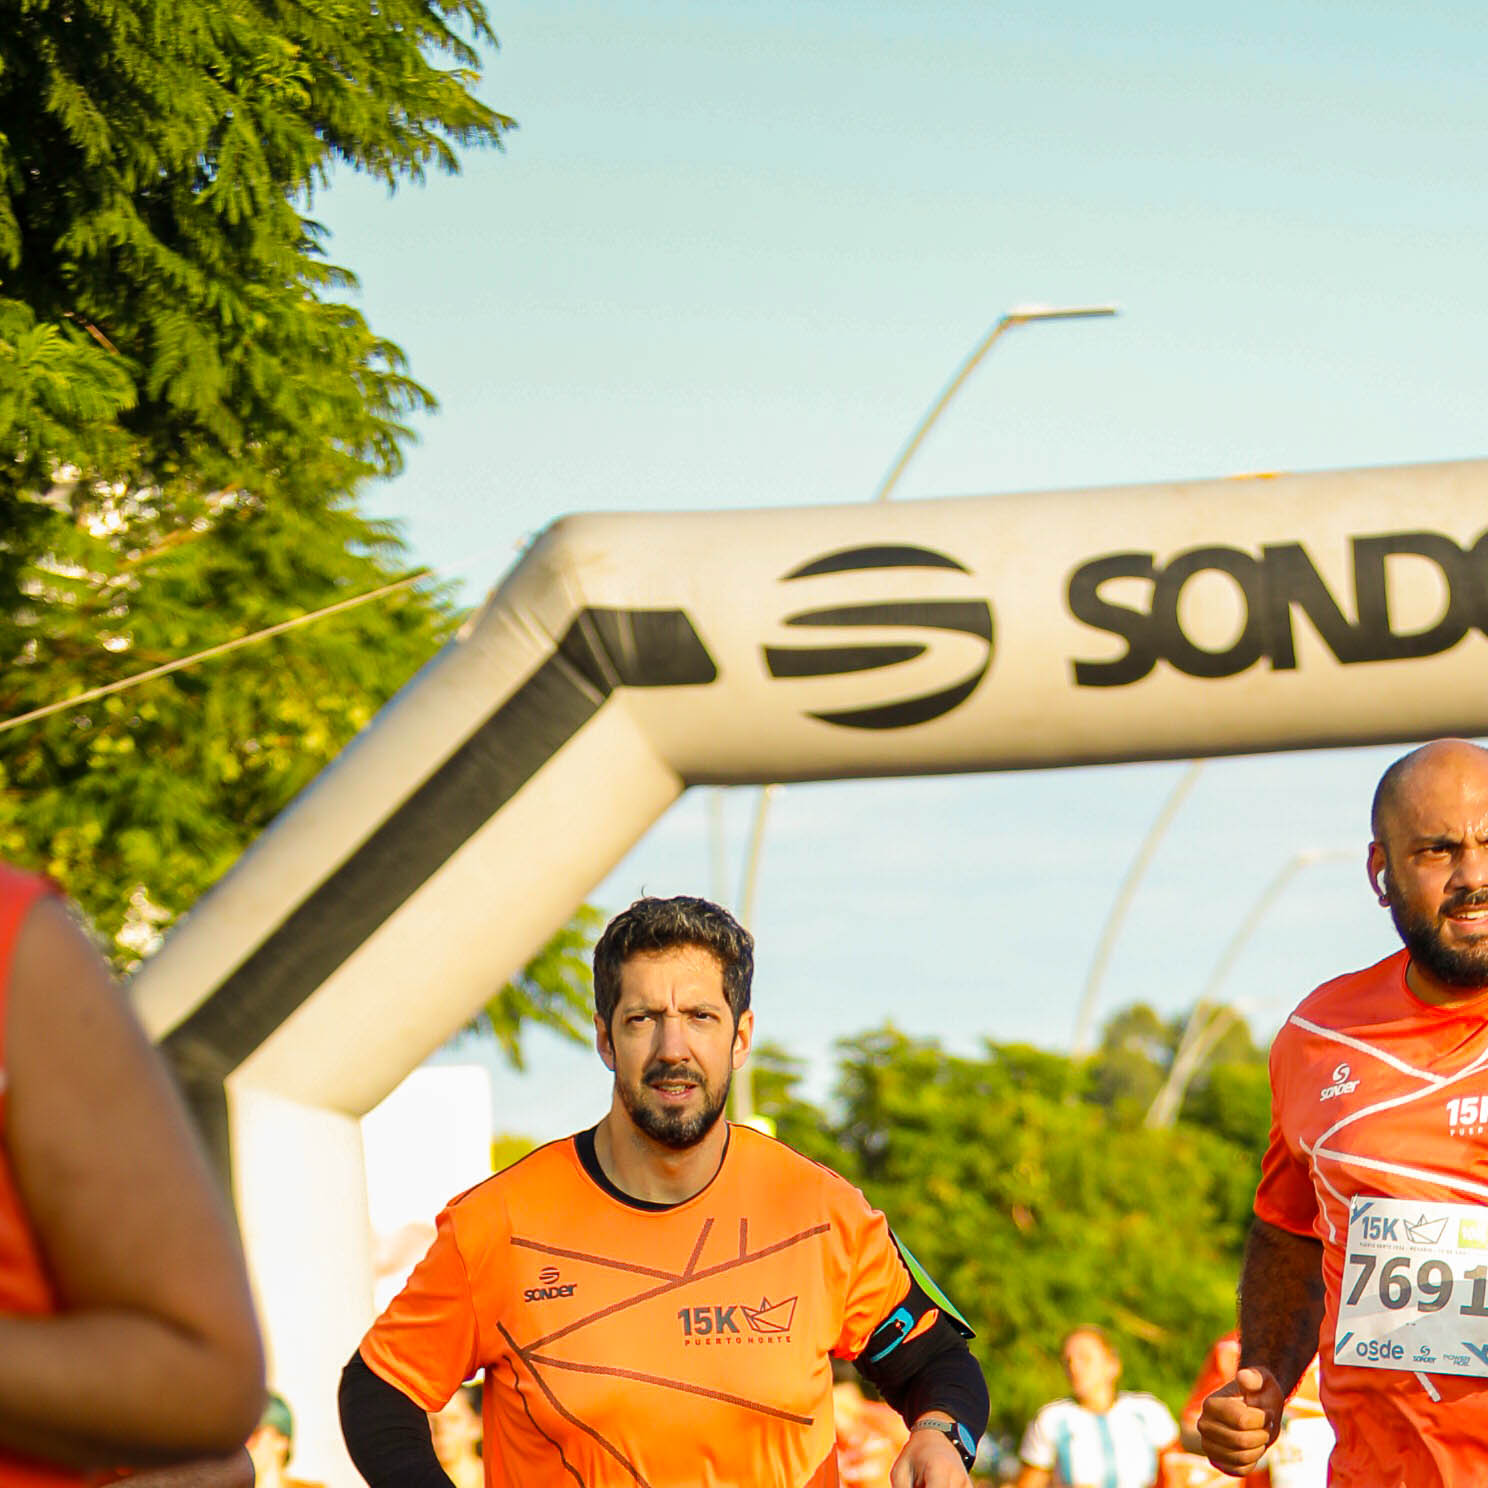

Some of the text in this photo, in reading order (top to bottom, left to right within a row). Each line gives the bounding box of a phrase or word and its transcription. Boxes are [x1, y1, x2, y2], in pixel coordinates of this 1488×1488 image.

[1361, 1215, 1399, 1241] 15K
[678, 1305, 740, 1336] 15K
[685, 1337, 742, 1346] PUERTO
[1356, 1340, 1404, 1361] osde
